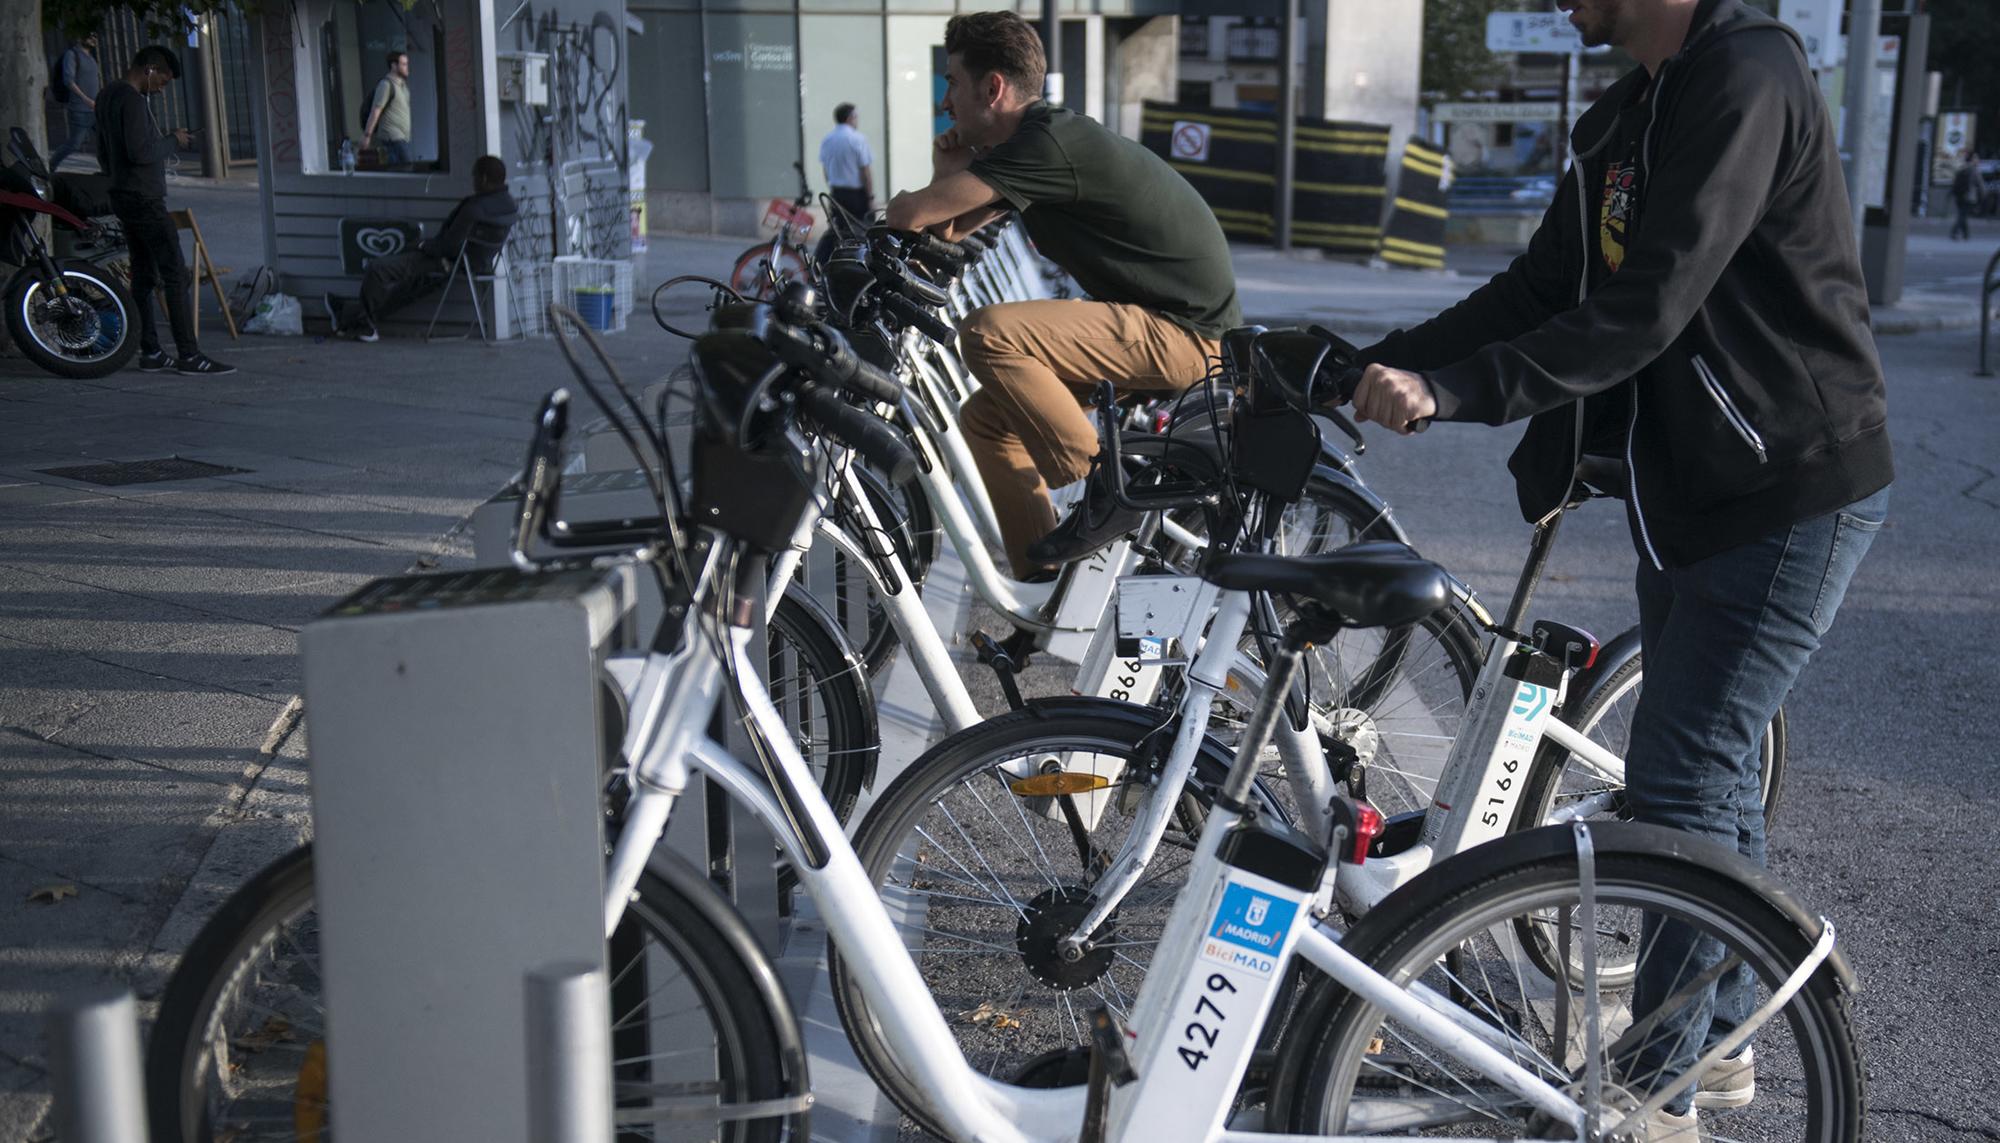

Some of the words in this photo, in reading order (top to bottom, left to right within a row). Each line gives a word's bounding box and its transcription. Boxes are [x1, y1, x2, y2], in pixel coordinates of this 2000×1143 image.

[1481, 759, 1519, 828] 5166
[1206, 943, 1272, 973] BiciMAD
[1177, 973, 1237, 1072] 4279
